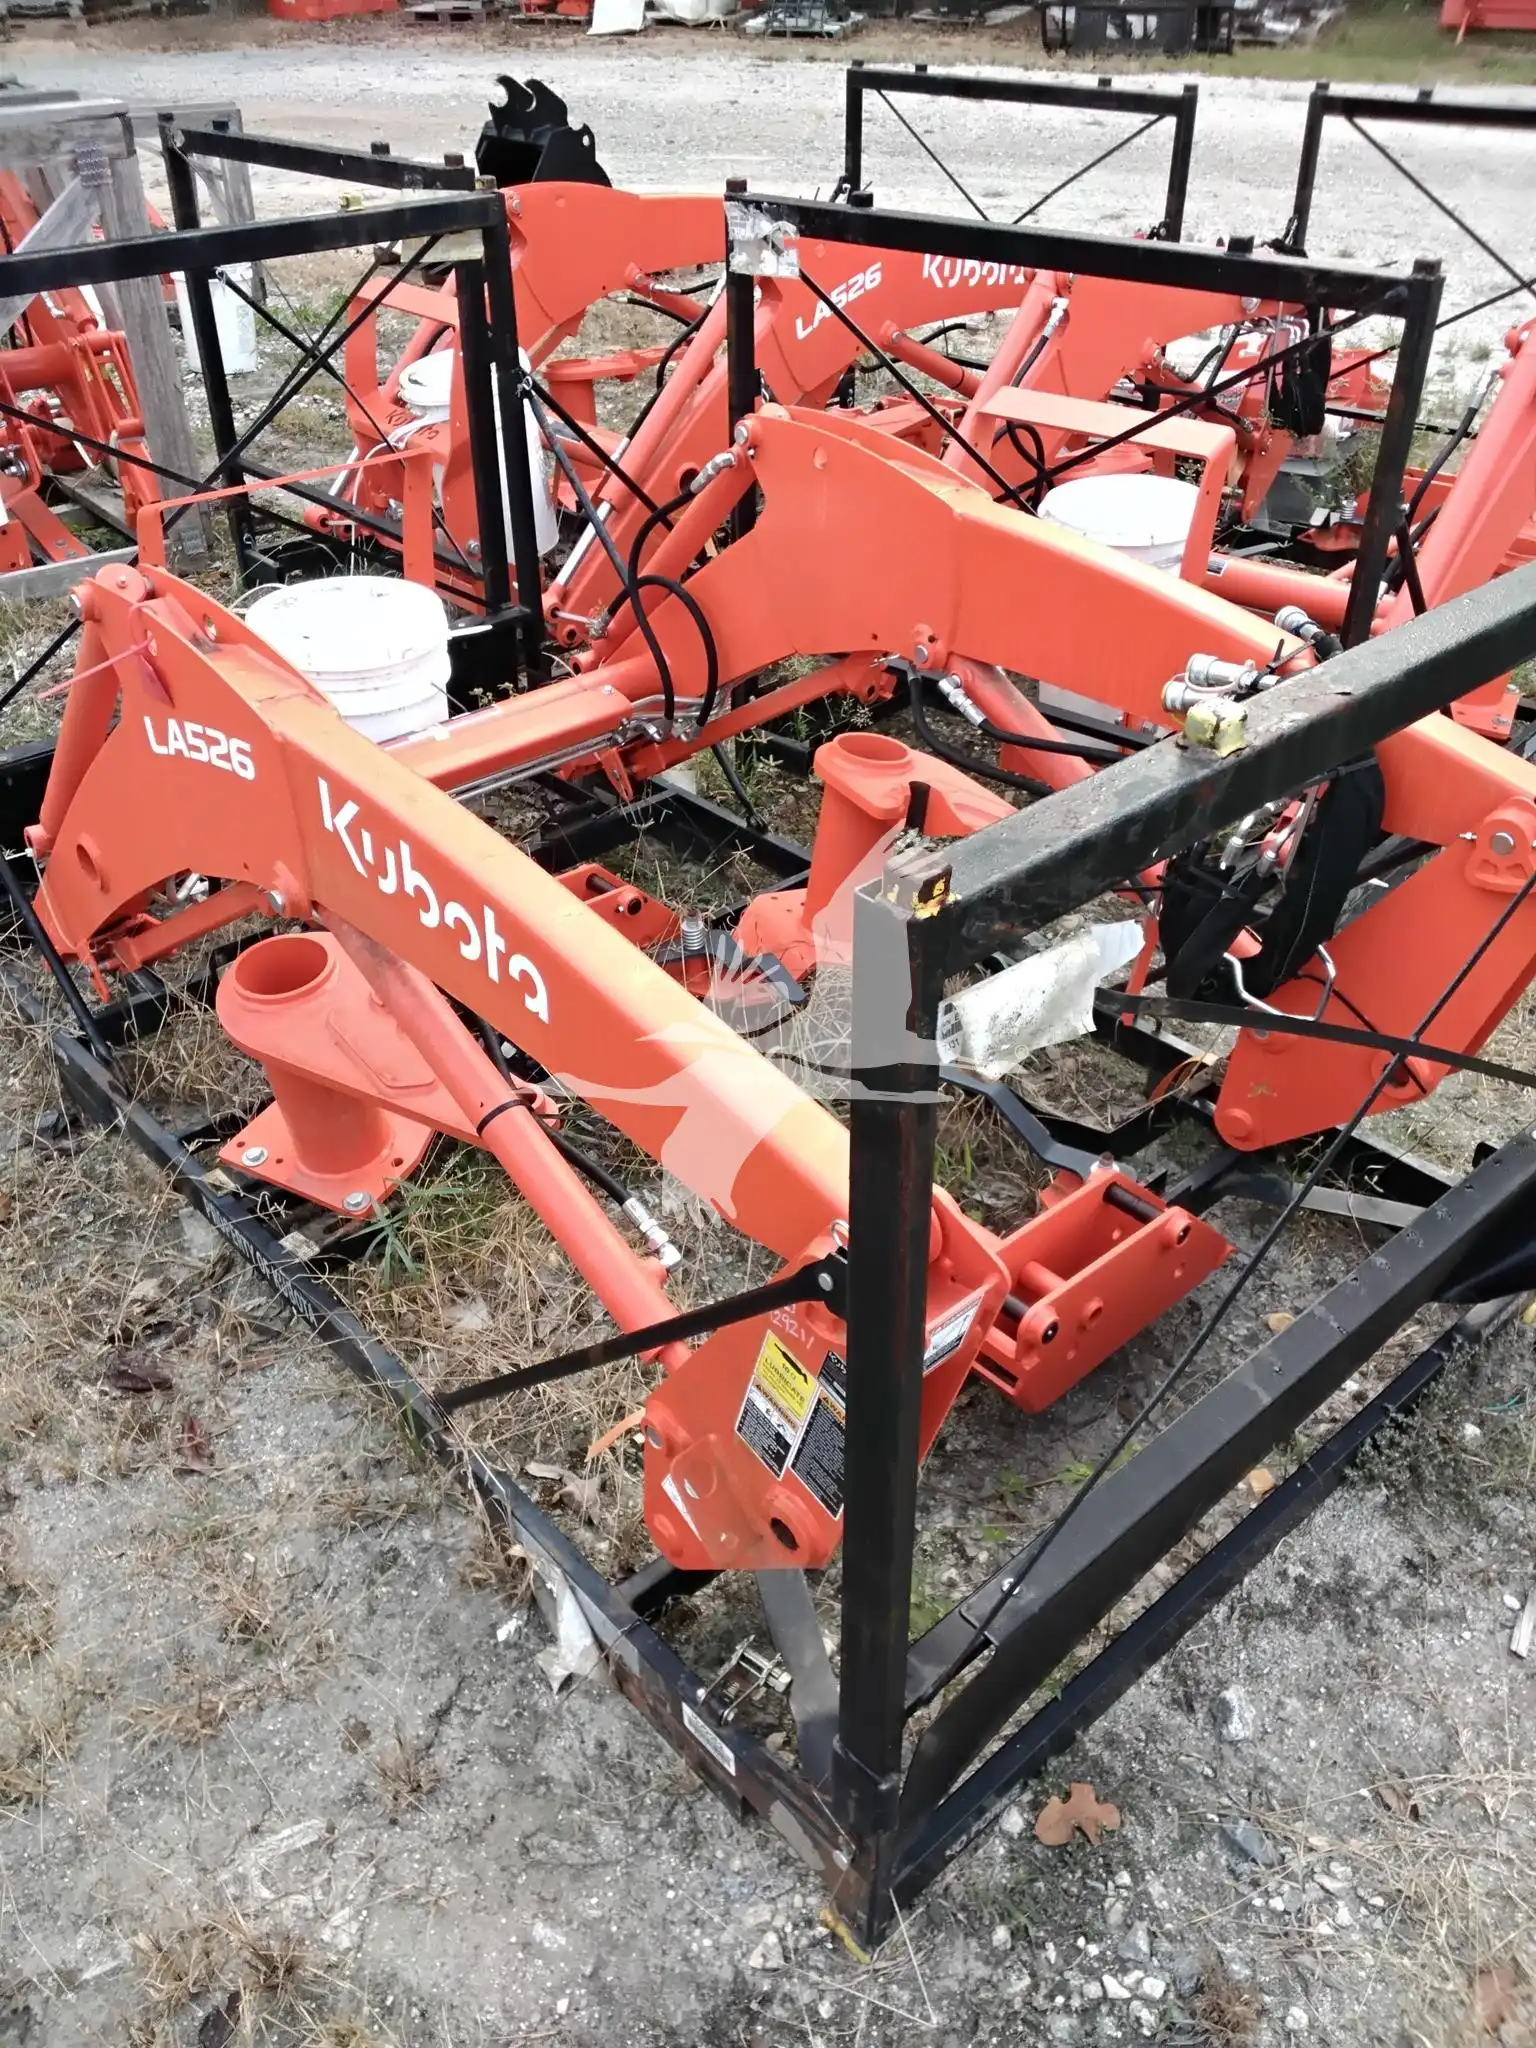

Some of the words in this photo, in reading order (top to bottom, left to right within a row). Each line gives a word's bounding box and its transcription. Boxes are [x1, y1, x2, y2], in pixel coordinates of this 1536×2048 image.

[794, 261, 882, 341] LA526
[143, 715, 256, 781] LA526
[317, 775, 550, 1025] Kubota
